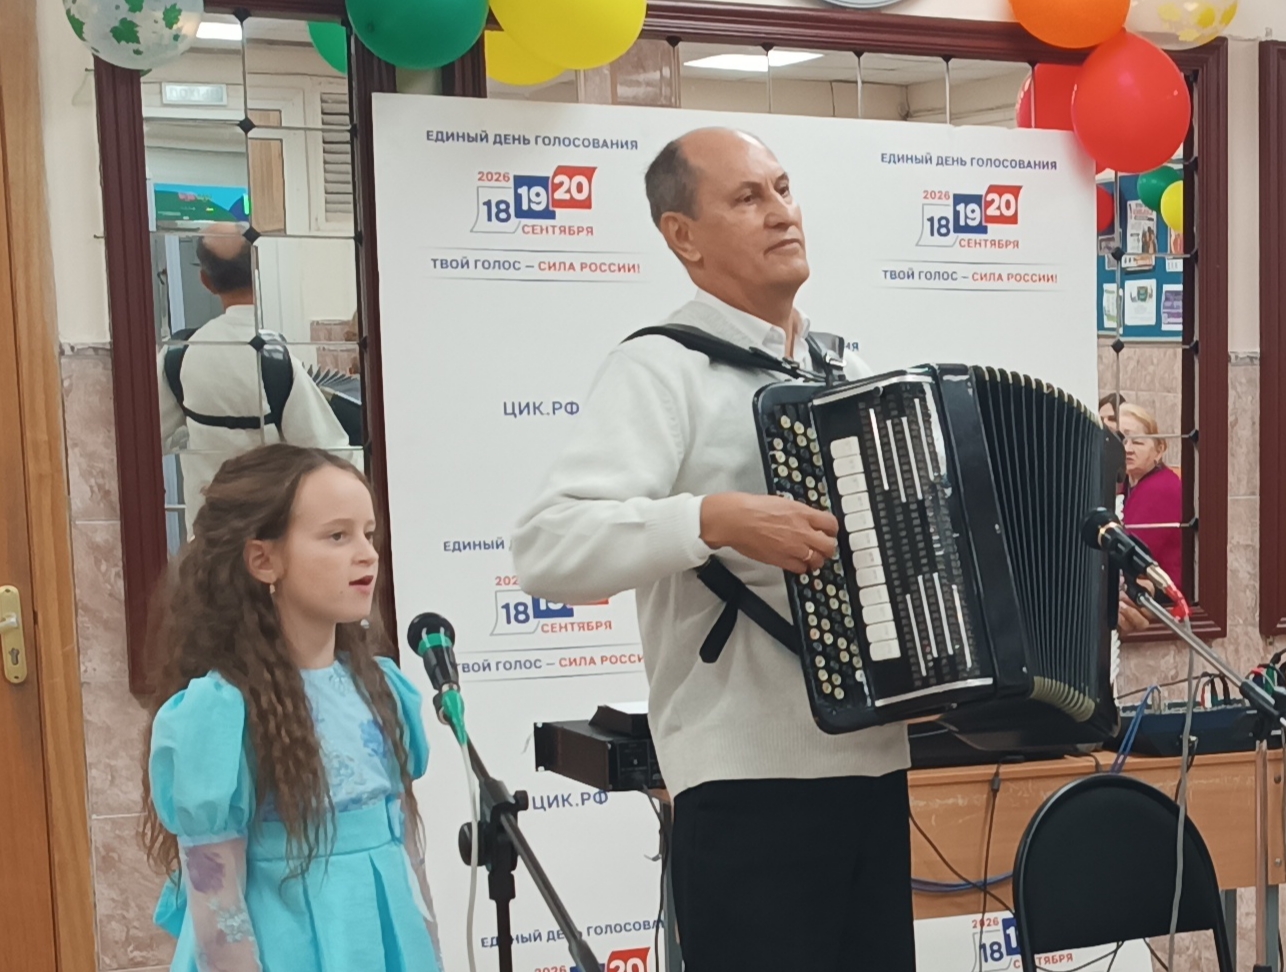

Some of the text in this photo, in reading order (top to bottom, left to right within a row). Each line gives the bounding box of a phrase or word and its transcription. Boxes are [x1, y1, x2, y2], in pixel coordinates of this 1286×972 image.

[426, 130, 638, 150] ЕДИНЫЙ ДЕНЬ ГОЛОСОВАНИЯ
[881, 153, 1057, 170] ЕДИНЫЙ ДЕНЬ ГОЛОСОВАНИЯ
[477, 171, 510, 182] 2026
[482, 174, 589, 223] 18 19 20
[923, 190, 950, 200] 2026
[926, 193, 1016, 237] 18 19 20
[521, 224, 594, 236] СЕНТЯБРЯ
[959, 238, 1019, 249] СЕНТЯБРЯ
[431, 256, 470, 270] ТВОЙ
[474, 259, 521, 271] ГОЛОС
[538, 261, 576, 272] СИЛА
[580, 262, 640, 273] РОССИИ!
[882, 268, 914, 280] ТВОЙ
[918, 270, 958, 281] ГОЛОС
[972, 272, 1003, 282] СИЛА
[1007, 273, 1057, 283] РОССИИ!
[503, 401, 580, 418] ЦИК.РФ
[444, 537, 505, 552] ЕДИНЫЙ
[495, 576, 519, 586] 202
[501, 602, 530, 625] 18
[541, 620, 613, 633] СЕНТЯБРЯ
[457, 659, 491, 673] ВОЙ
[496, 658, 542, 671] ГОЛОС
[559, 656, 597, 667] СИЛА
[532, 790, 608, 811] ЦИК.РФ
[481, 929, 542, 948] ЕДЫЙ
[546, 929, 565, 943] ДЕ
[980, 941, 1004, 963] 18
[1013, 953, 1073, 969] СТЯБРЯ
